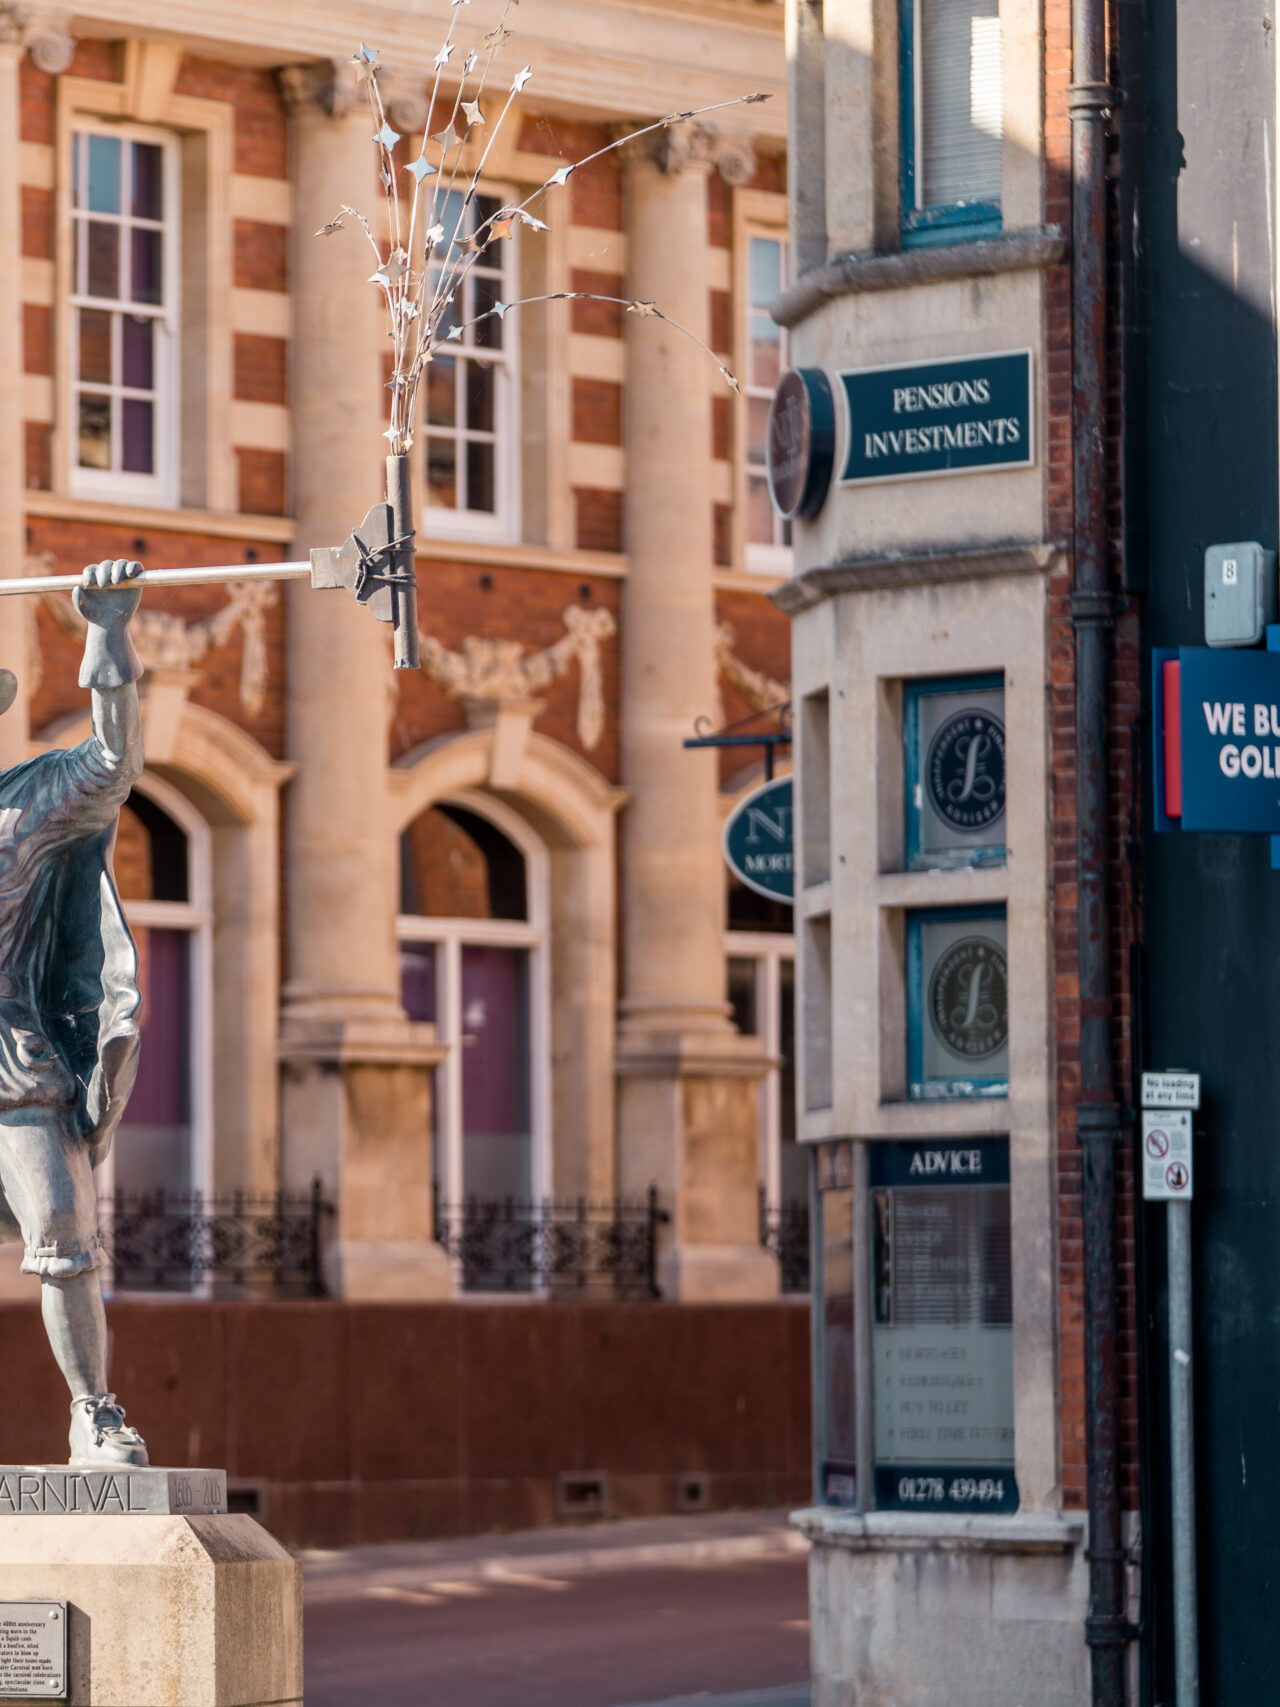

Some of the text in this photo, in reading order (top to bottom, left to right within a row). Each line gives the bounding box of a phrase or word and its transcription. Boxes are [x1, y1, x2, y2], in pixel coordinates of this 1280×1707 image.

[892, 378, 991, 414] PENSIONS
[864, 417, 1020, 459] INVESTMENTS
[1226, 563, 1234, 580] 8
[1202, 702, 1246, 736] WE
[1146, 1091, 1154, 1099] at
[1176, 1090, 1195, 1099] time
[1147, 1078, 1195, 1089] No loading
[910, 1150, 982, 1176] ADVICE
[898, 1478, 1004, 1503] 01278 439494
